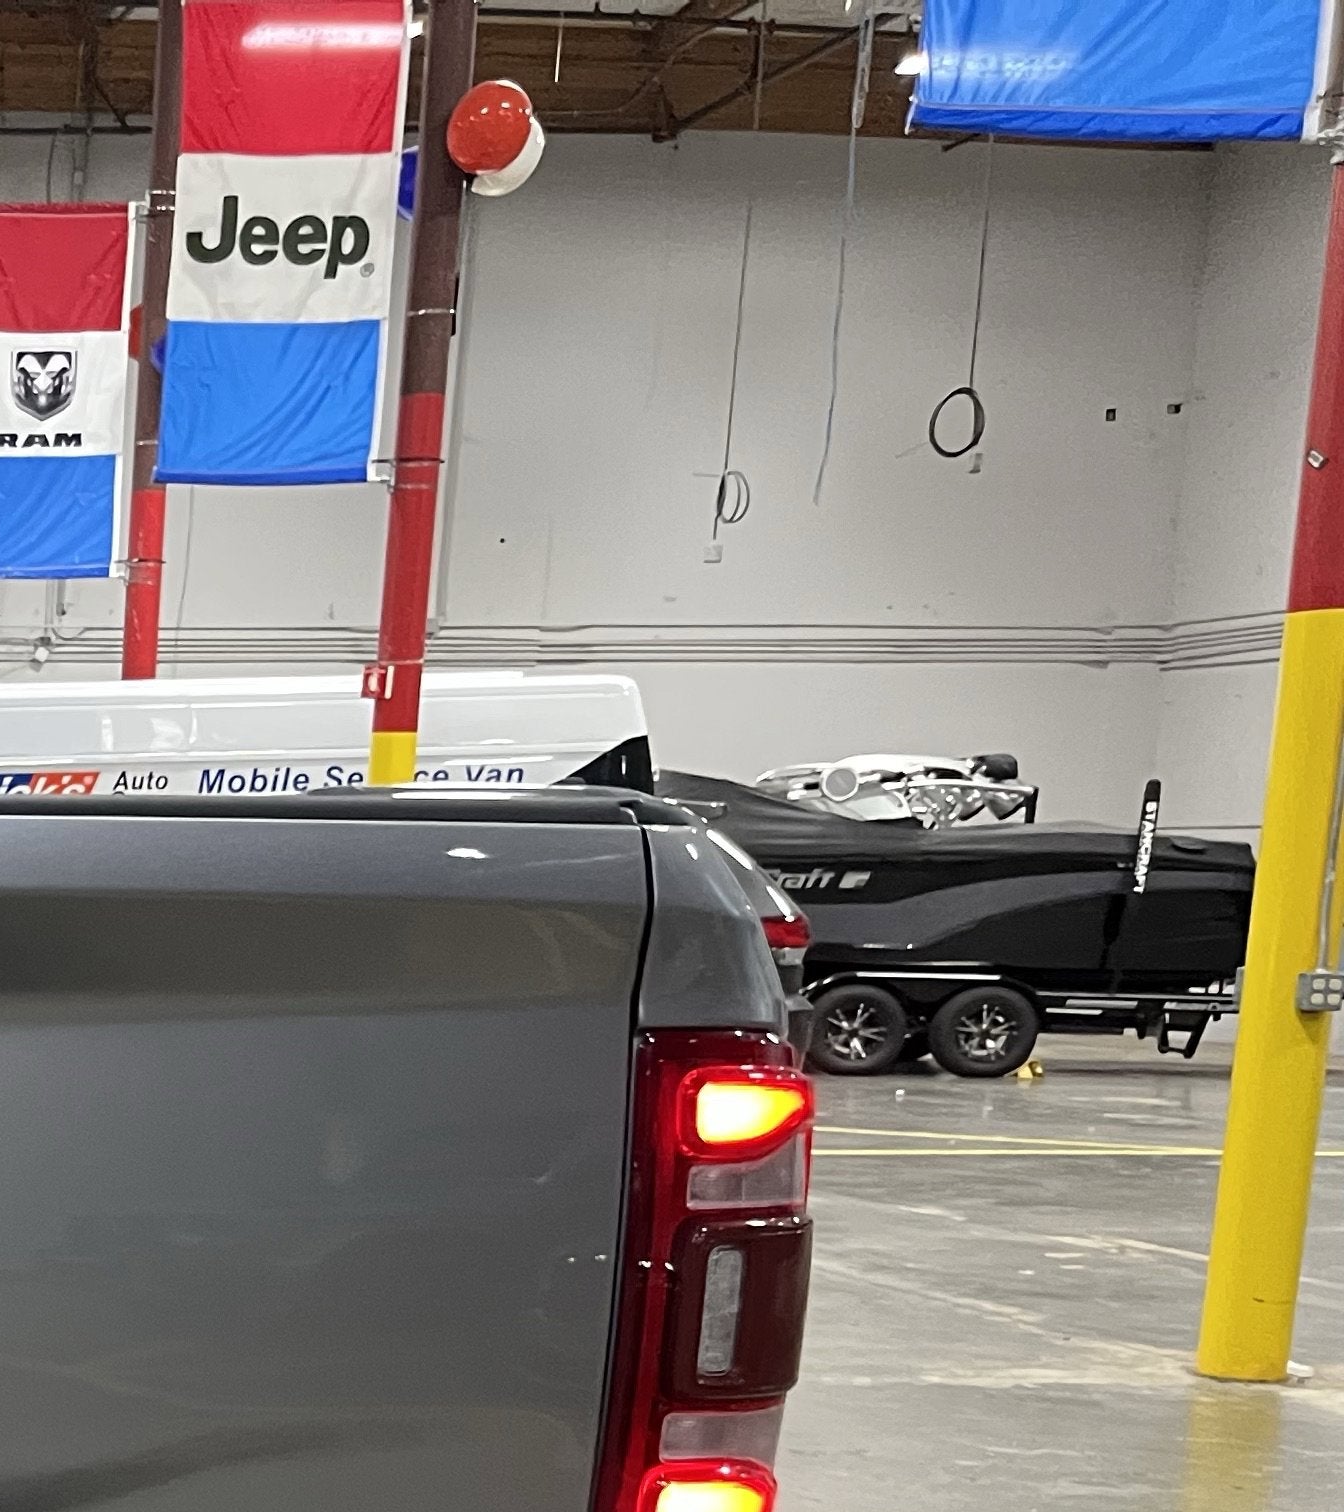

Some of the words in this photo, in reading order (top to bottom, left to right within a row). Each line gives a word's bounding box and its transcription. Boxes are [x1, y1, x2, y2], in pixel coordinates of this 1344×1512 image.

[185, 195, 371, 279] Jeep
[113, 771, 169, 791] Auto
[198, 767, 310, 793] Mobile
[325, 766, 450, 787] Sece
[466, 765, 524, 783] Van
